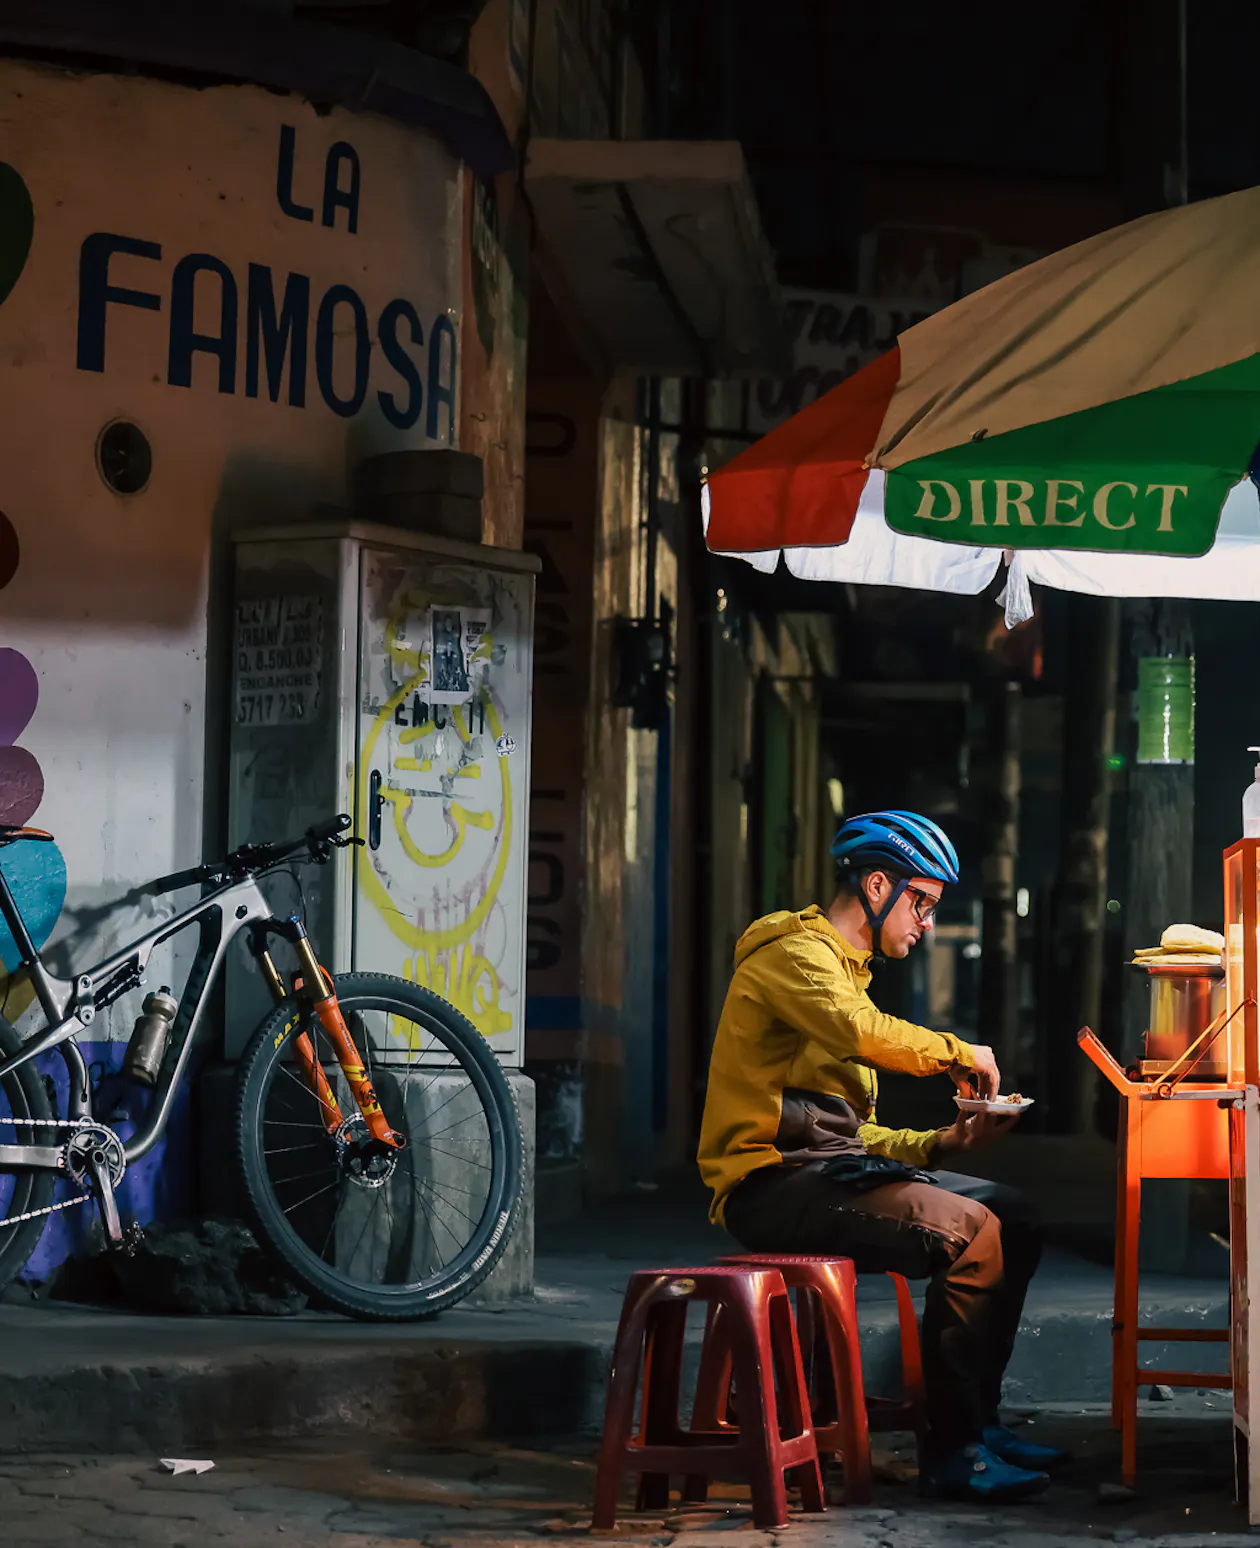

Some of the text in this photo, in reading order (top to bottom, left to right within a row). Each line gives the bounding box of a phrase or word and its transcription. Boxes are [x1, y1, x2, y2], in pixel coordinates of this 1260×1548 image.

[277, 124, 360, 234] LA
[77, 233, 456, 447] FAMOSA
[913, 479, 1189, 533] DIRECT
